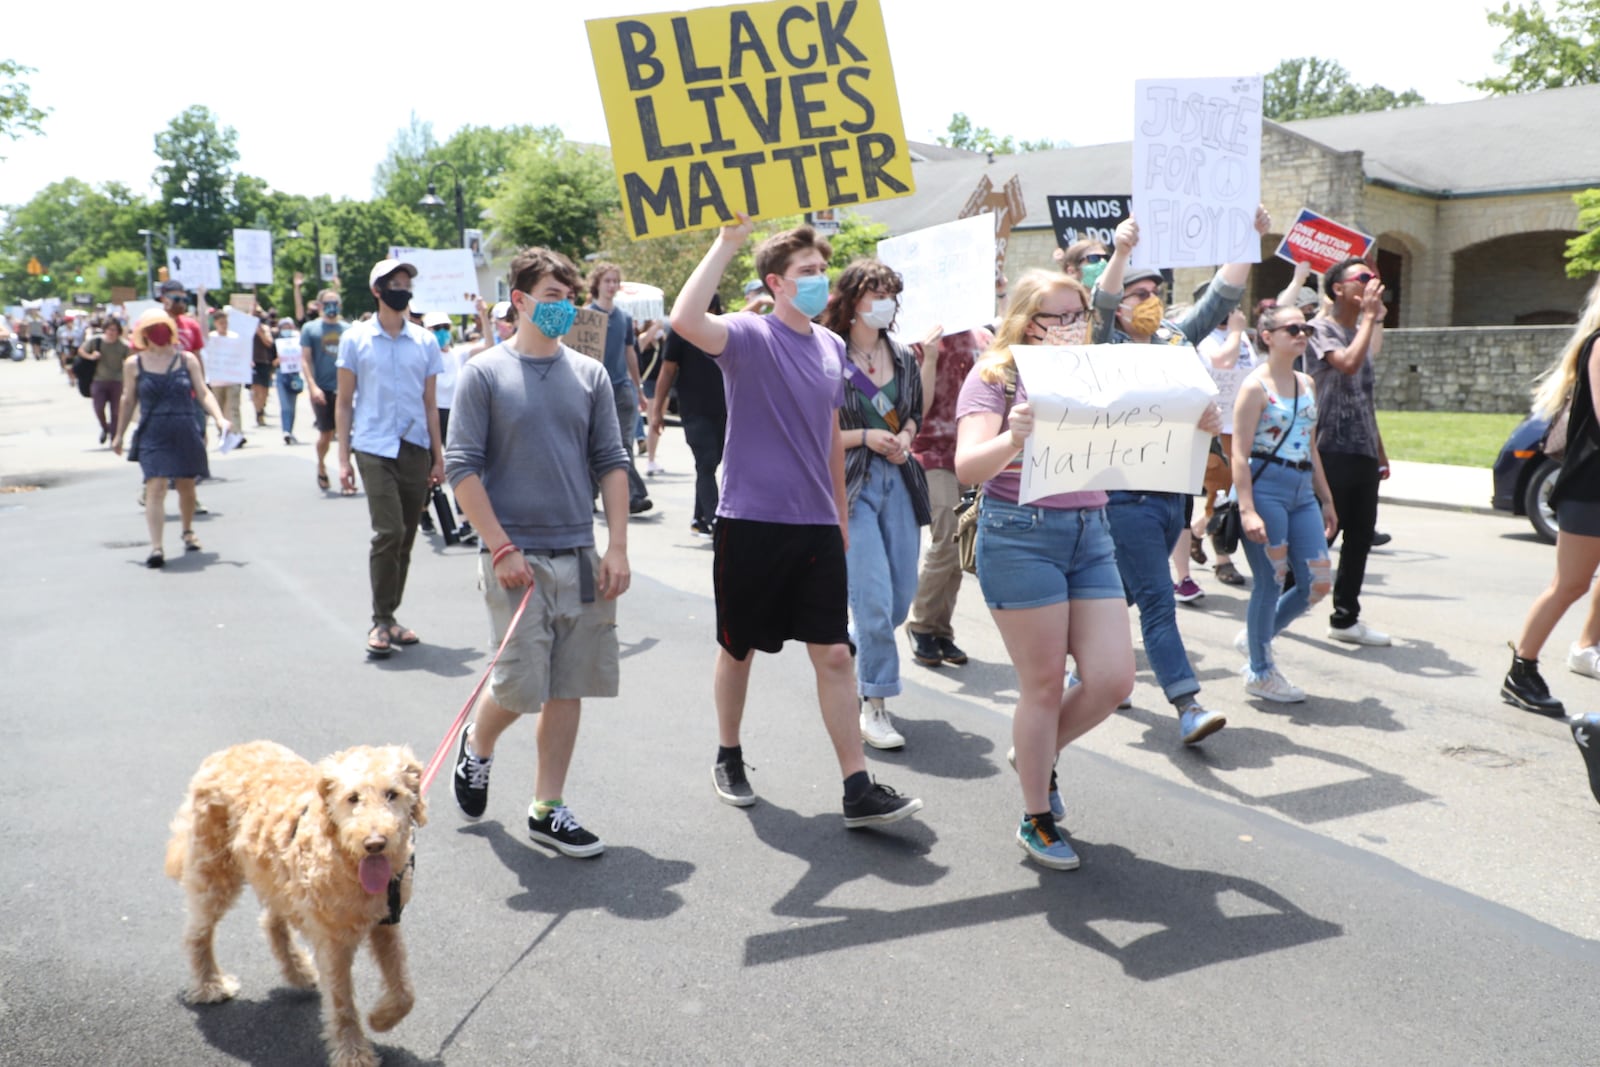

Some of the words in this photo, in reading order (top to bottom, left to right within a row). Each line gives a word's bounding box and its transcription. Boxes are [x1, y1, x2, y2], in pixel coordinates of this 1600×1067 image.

[616, 0, 869, 92] BLACK
[635, 66, 875, 162] LIVES
[1140, 86, 1260, 156] JUSTICE
[623, 132, 910, 237] MATTER
[1144, 143, 1206, 197] FOR
[1055, 199, 1122, 219] HANDS
[1148, 198, 1252, 265] FLOYD
[1294, 222, 1317, 237] ONE
[1313, 231, 1353, 251] NATION
[1057, 403, 1164, 431] Lives
[1028, 430, 1172, 489] Matter!
